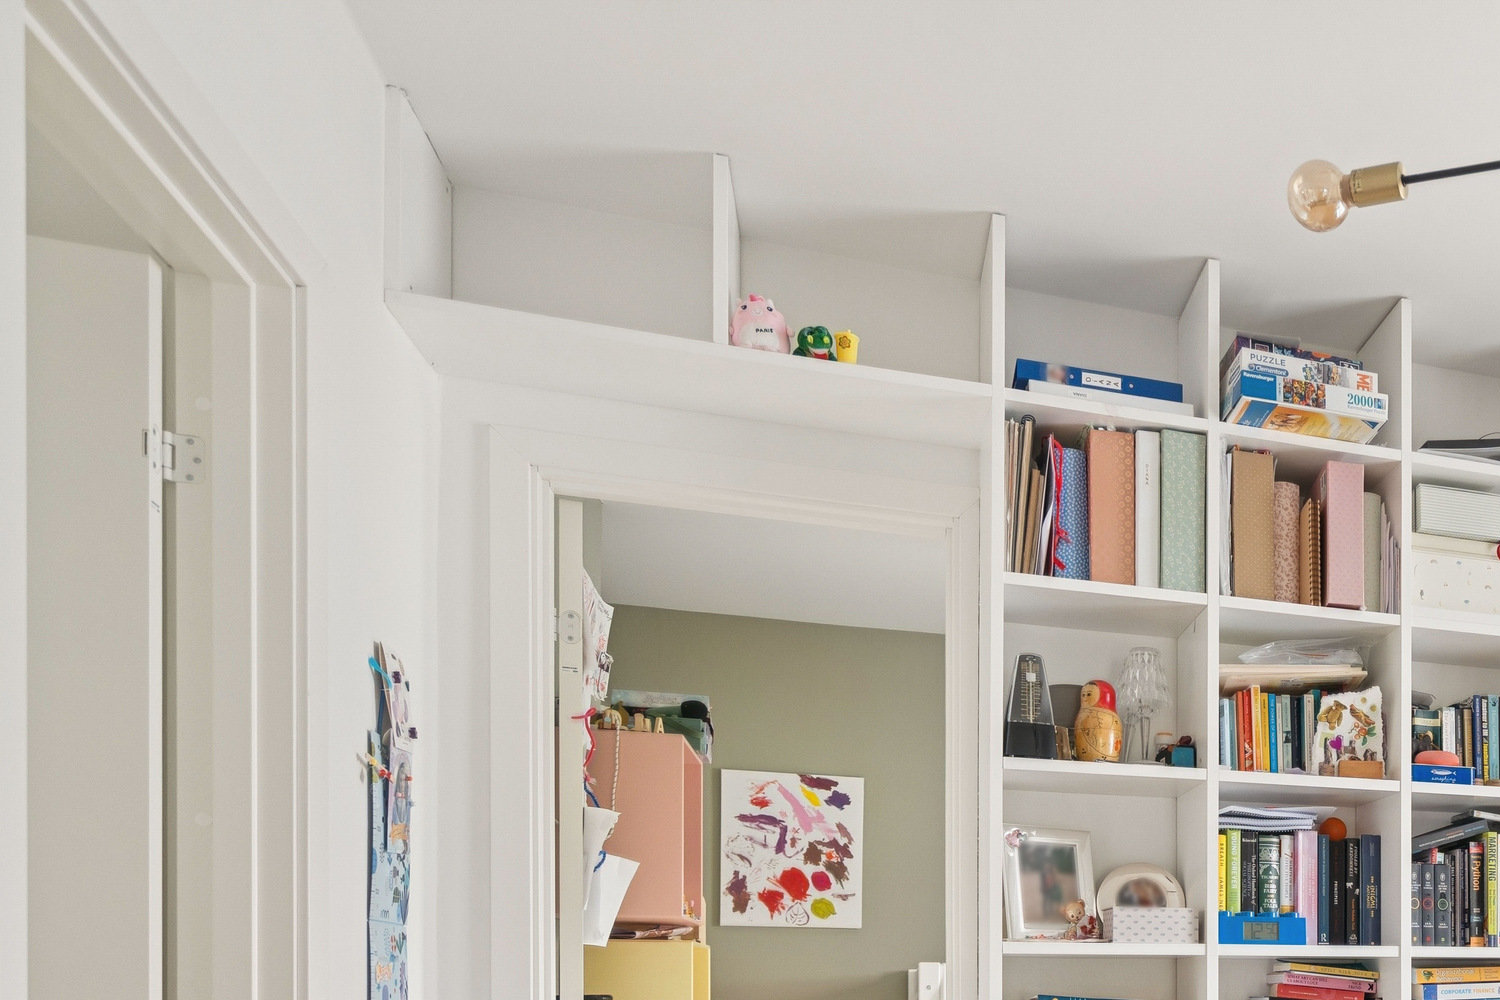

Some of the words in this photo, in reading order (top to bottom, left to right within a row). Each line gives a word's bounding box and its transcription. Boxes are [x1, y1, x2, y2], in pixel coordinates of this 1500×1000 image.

[1250, 353, 1286, 367] PUZZLE
[1086, 377, 1119, 387] DIANA
[1347, 393, 1373, 408] 2000
[1488, 836, 1497, 882] MARKETING
[1472, 860, 1481, 891] Python
